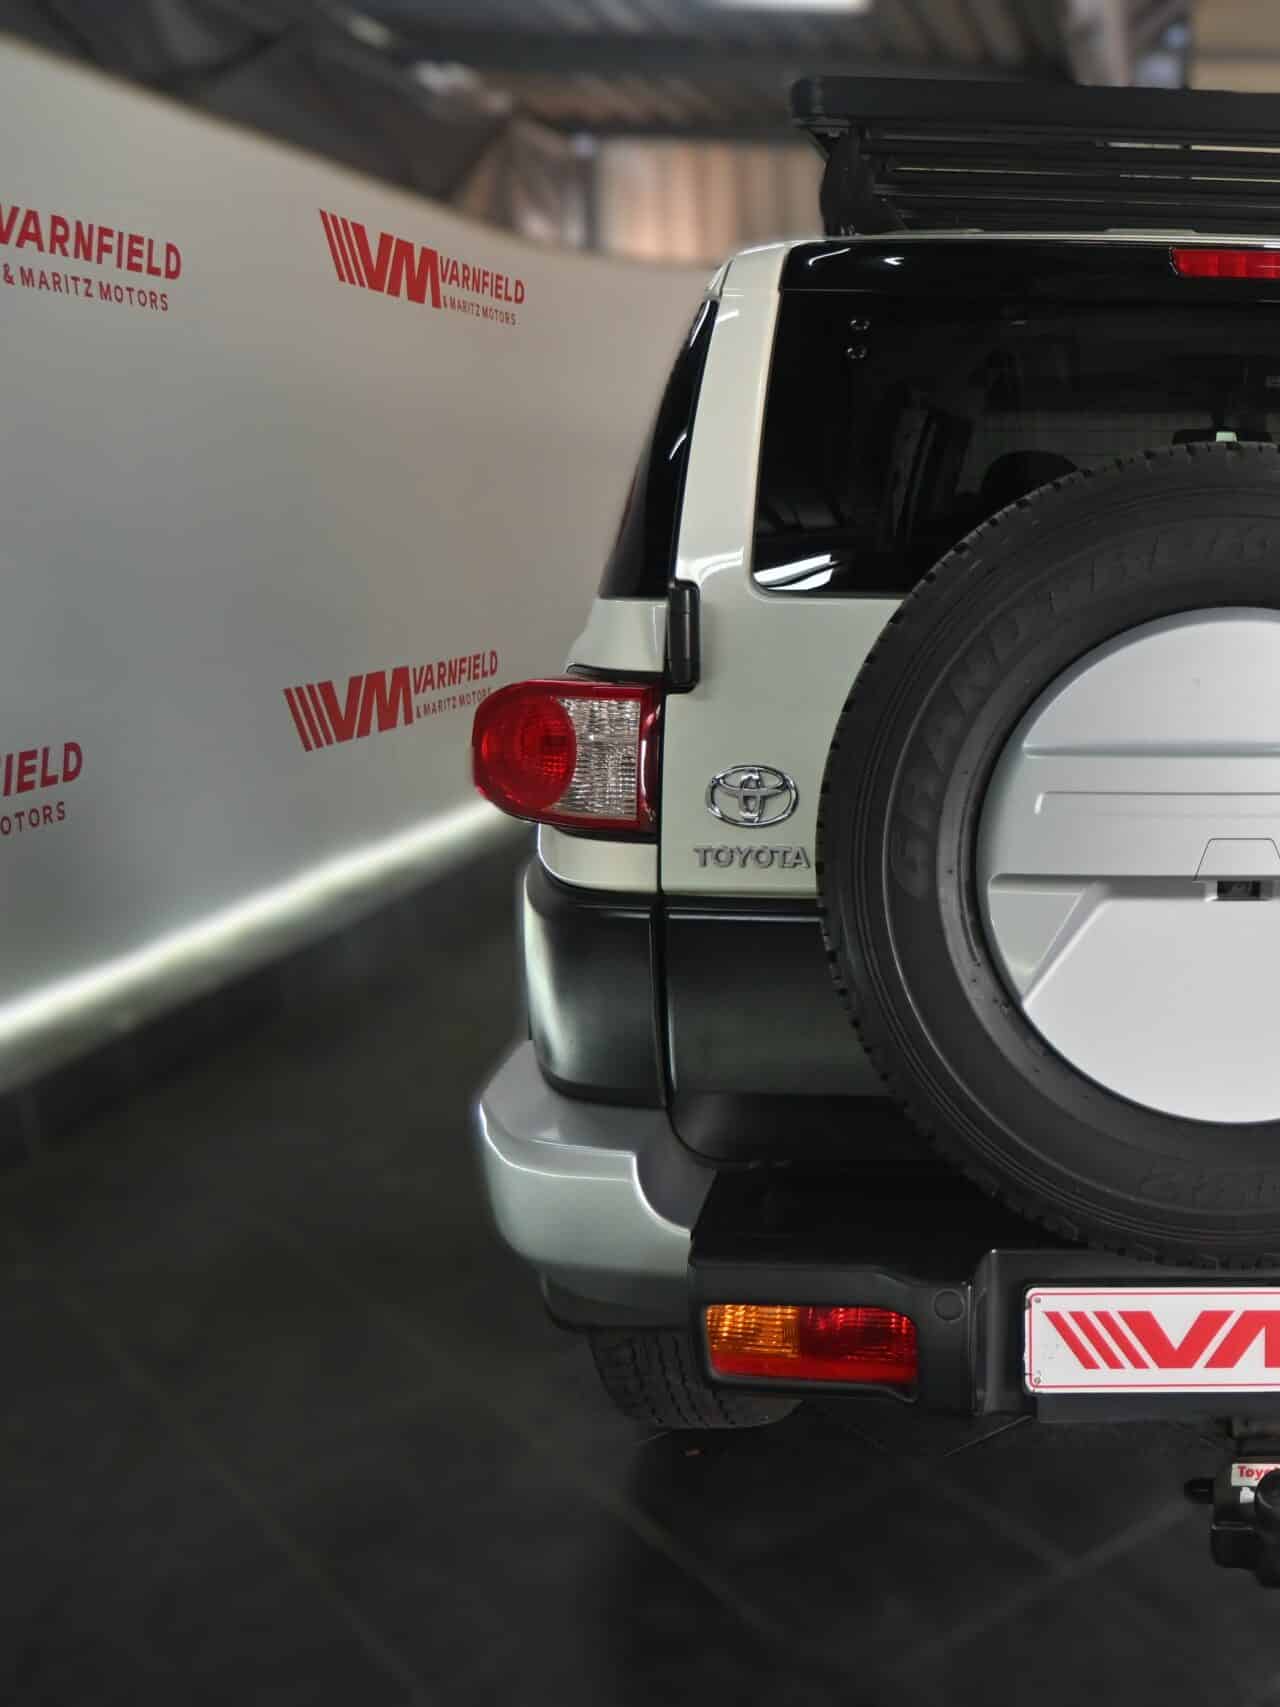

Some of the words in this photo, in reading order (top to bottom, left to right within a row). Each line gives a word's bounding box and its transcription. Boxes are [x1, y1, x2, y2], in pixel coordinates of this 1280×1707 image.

[0, 203, 182, 280] VARNFIELD
[335, 212, 442, 310] VM
[3, 263, 16, 286] &
[19, 265, 94, 298] MARITZ
[98, 280, 169, 312] MOTORS
[440, 255, 525, 304] VARNFIELD
[449, 296, 480, 318] MARITZ
[481, 307, 517, 326] MOTORS
[412, 650, 498, 695] VARNFIELD
[300, 665, 414, 748] VM
[423, 698, 457, 716] MARITZ
[0, 742, 83, 797] IELD
[0, 801, 66, 835] OTORS
[693, 845, 811, 869] TOYOTA
